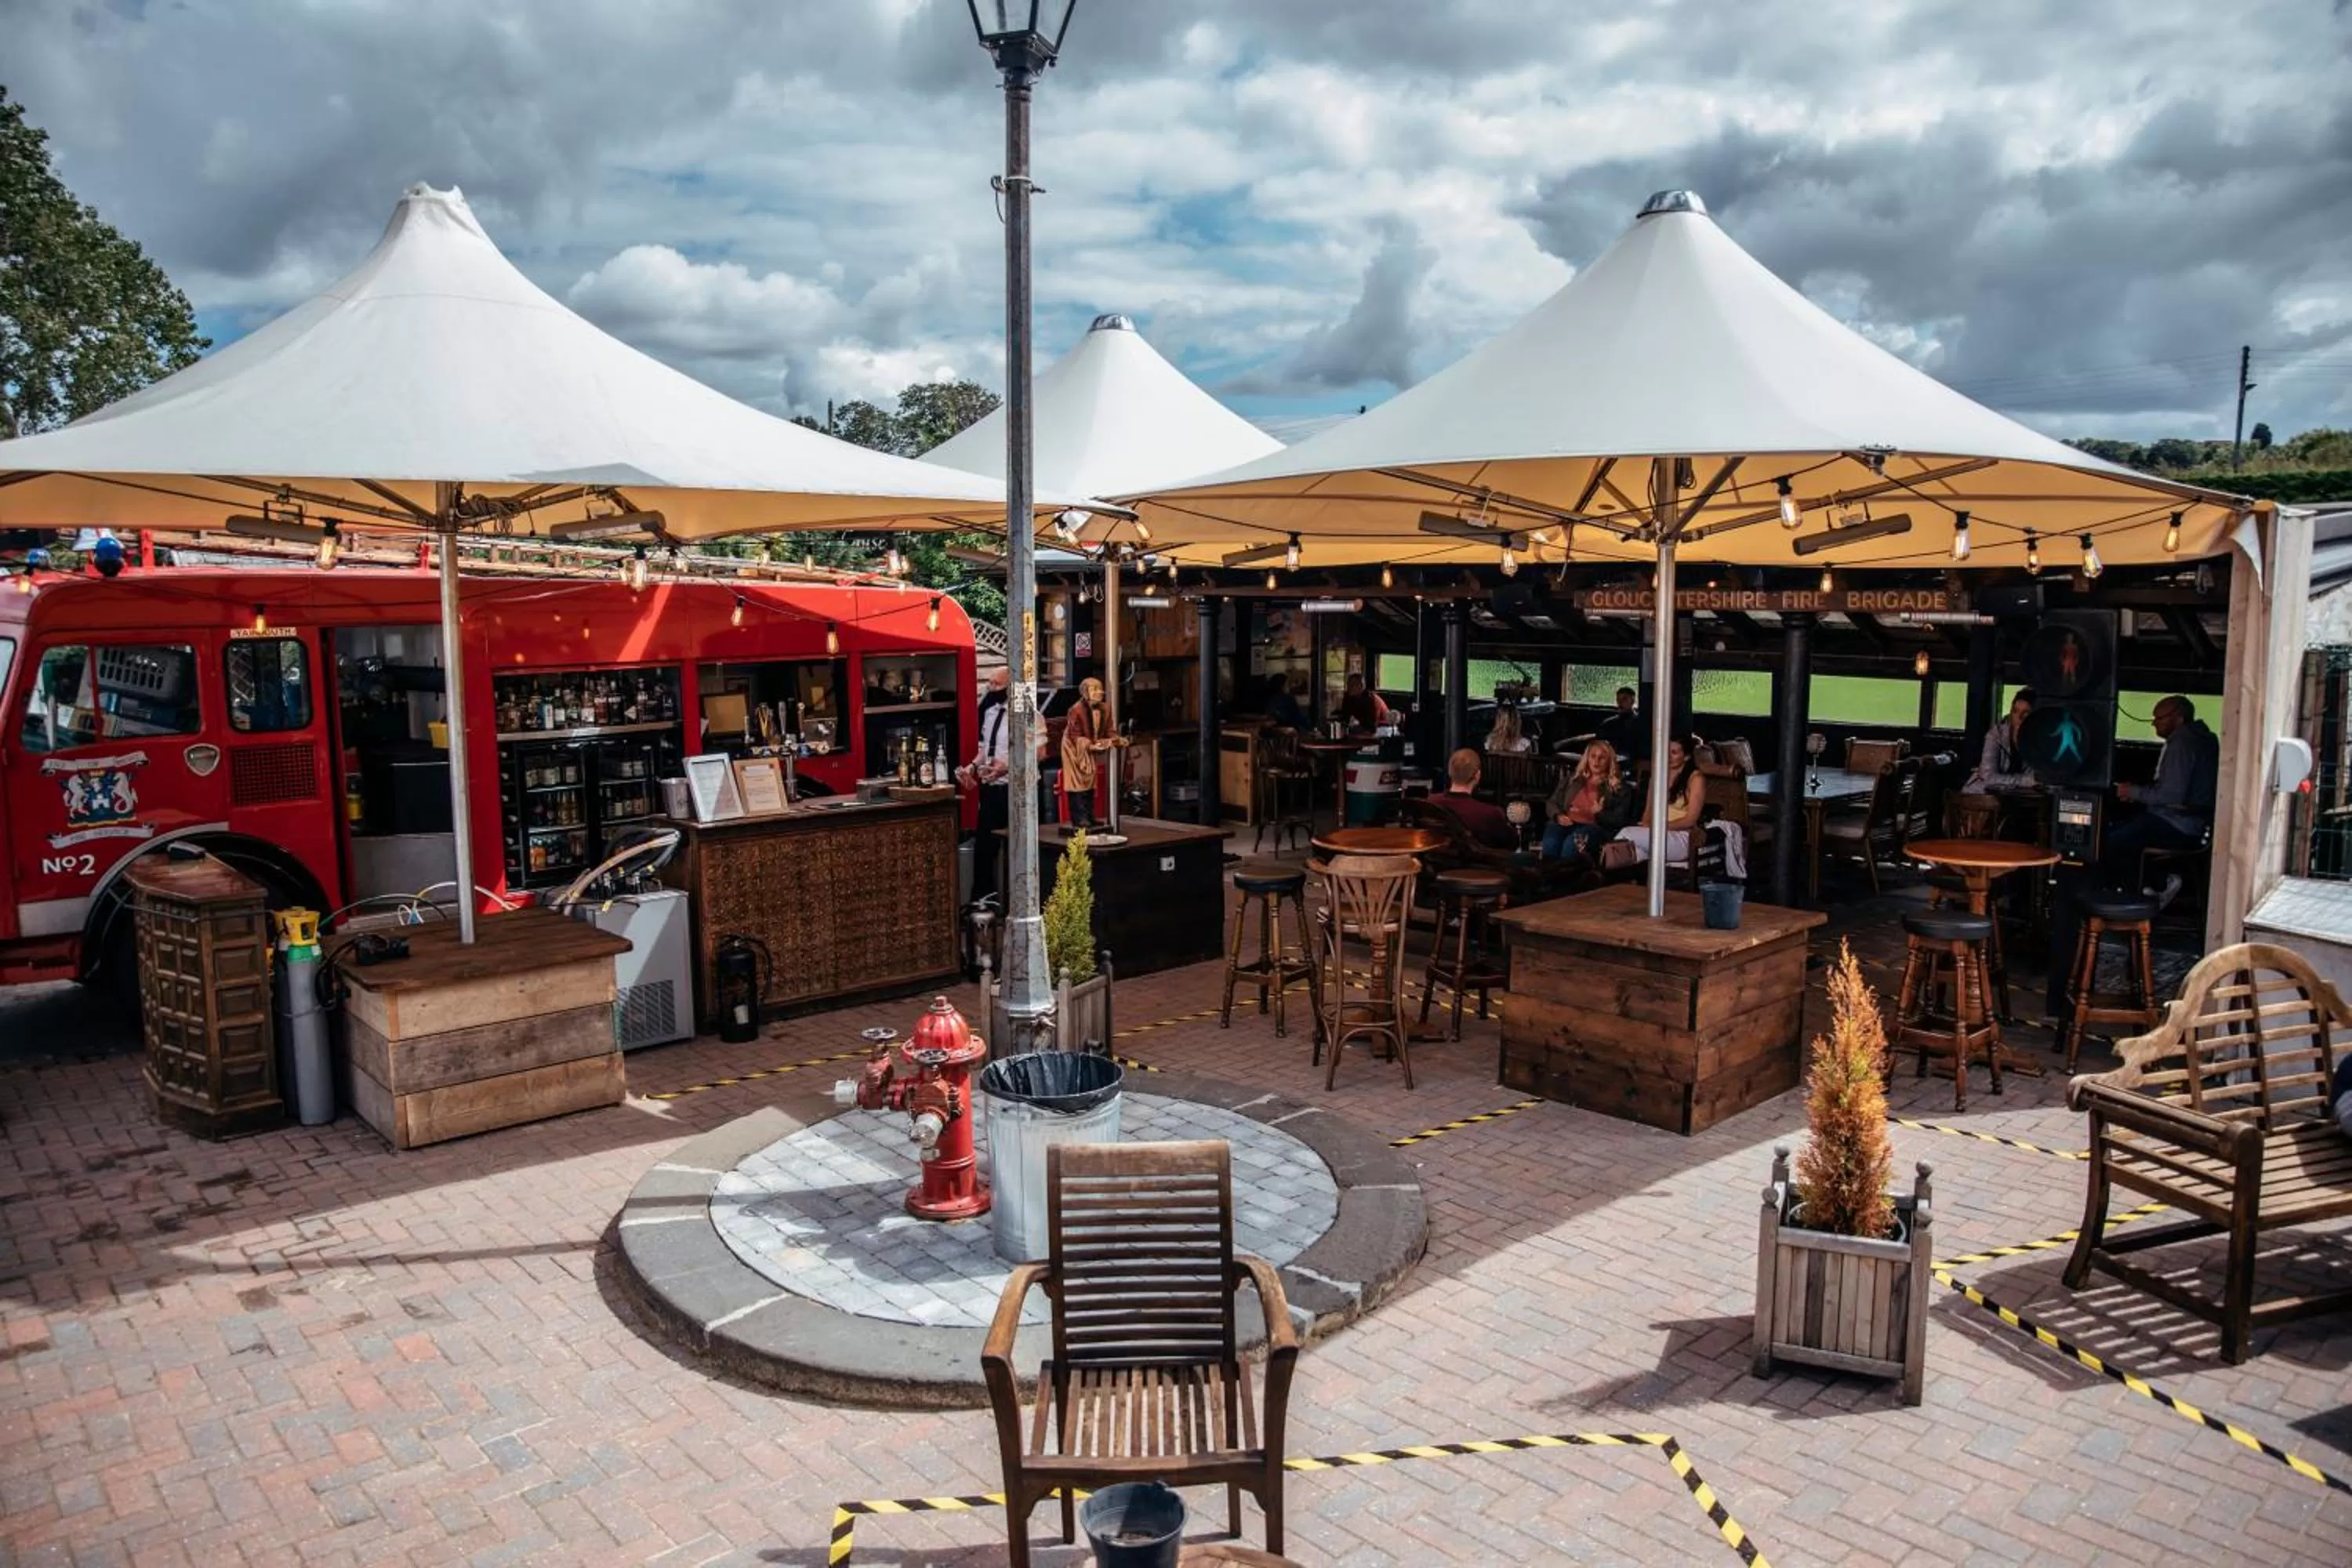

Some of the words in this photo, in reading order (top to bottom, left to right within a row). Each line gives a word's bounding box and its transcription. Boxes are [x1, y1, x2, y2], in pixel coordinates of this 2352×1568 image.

[1592, 590, 1766, 608] GLOUCTERSHIRE
[1782, 590, 1825, 608] FIRE
[1846, 591, 1947, 610] BRIGADE
